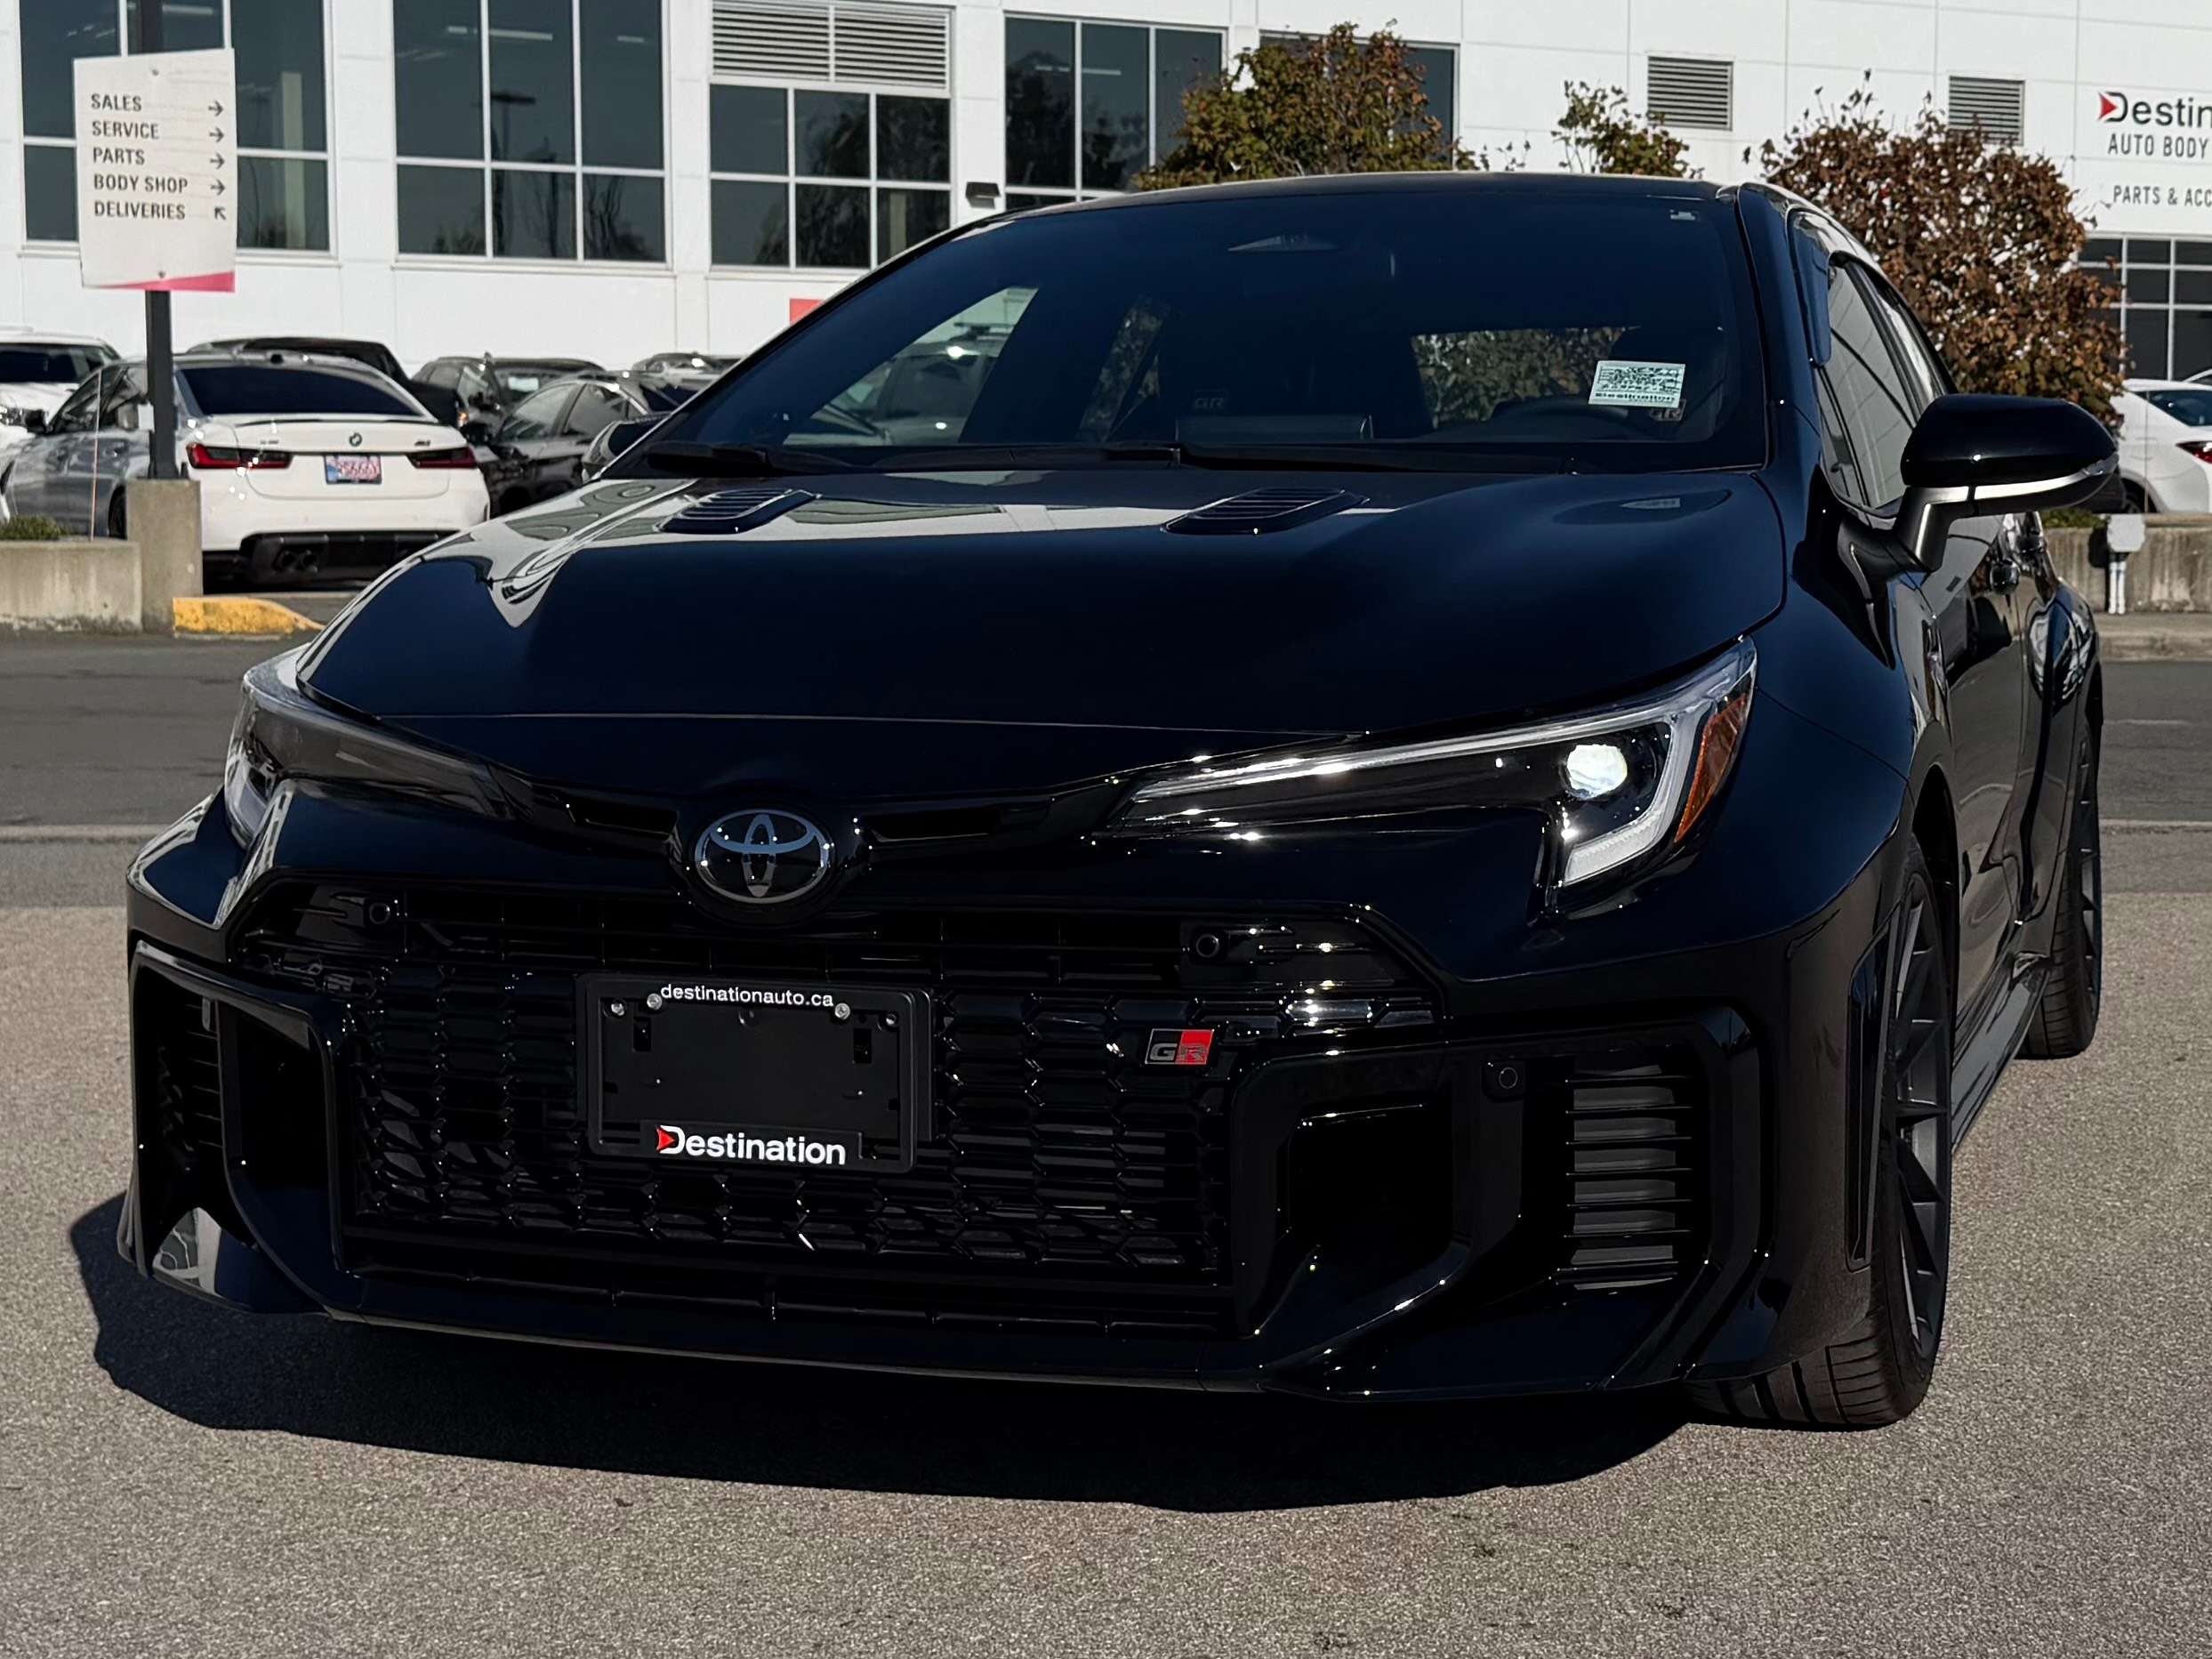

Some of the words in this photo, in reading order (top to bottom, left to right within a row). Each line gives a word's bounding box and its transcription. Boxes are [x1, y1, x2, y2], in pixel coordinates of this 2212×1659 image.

[91, 93, 142, 112] SALES
[92, 121, 159, 140] SERVICE
[93, 147, 145, 165] PARTS
[2107, 133, 2155, 157] AUTO
[2162, 135, 2208, 160] BODY
[93, 173, 140, 191] BODY
[144, 175, 188, 194] SHOP
[2113, 185, 2161, 205] PARTS
[2168, 187, 2178, 206] &
[94, 200, 186, 221] DELIVERIES
[660, 984, 834, 1008] destinationauto.ca
[1149, 1043, 1206, 1061] GR
[656, 1124, 846, 1165] Destination
